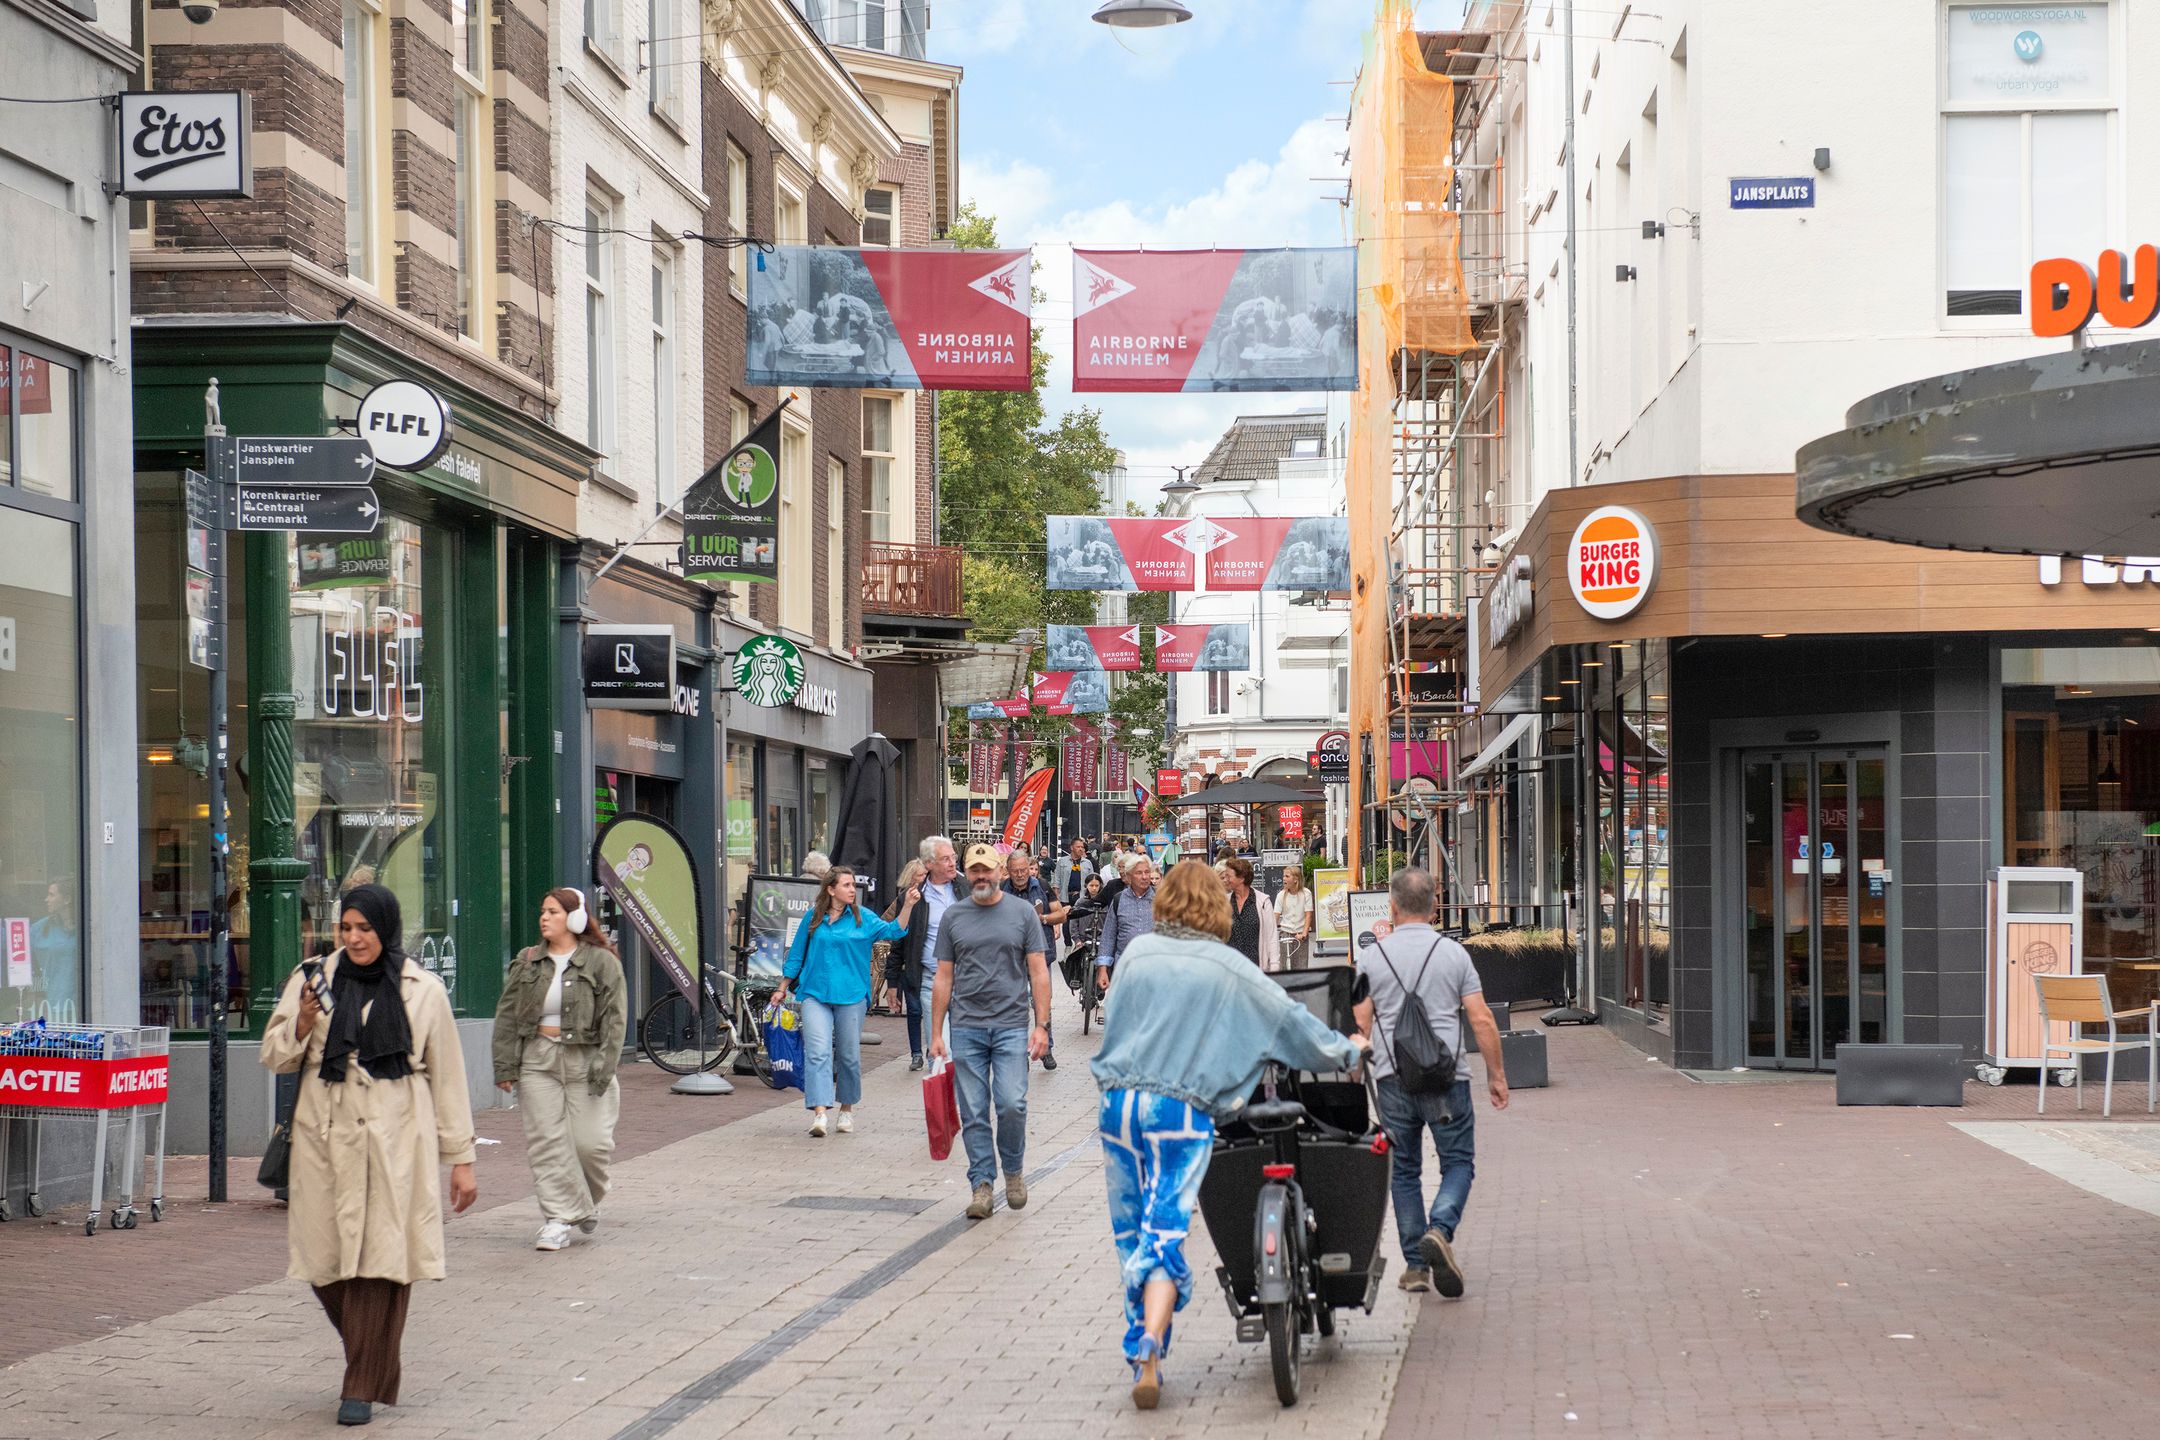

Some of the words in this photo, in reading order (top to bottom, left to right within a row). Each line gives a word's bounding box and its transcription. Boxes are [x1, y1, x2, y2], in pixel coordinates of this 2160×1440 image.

[1969, 10, 2087, 21] WOODWORKSYOGA.NL
[1996, 78, 2029, 90] urban
[2032, 79, 2060, 92] yoga
[133, 105, 226, 158] Etos
[1734, 186, 1809, 201] JANSPLAATS
[1090, 335, 1188, 349] AIRBORNE
[1090, 352, 1170, 366] ARNHEM
[370, 411, 430, 437] FLFL
[241, 444, 314, 453] Janskwartier
[241, 456, 295, 466] Jansplein
[456, 453, 481, 485] falafel
[242, 490, 322, 501] Korenkwartier
[256, 502, 304, 512] Centraal
[242, 514, 309, 524] Korenmarkt
[685, 514, 775, 523] DIRECTFIXPHONE.NL
[687, 534, 696, 554] 1
[702, 535, 738, 554] UUR
[1580, 541, 1640, 562] BURGER
[688, 555, 738, 567] SERVICE
[1213, 561, 1265, 569] AIRBORNE
[1581, 560, 1641, 588] KING
[1280, 808, 1301, 819] alles
[765, 896, 775, 912] 1
[787, 899, 810, 912] UUR
[0, 1068, 81, 1094] ACTIE
[108, 1070, 139, 1095] ACTIE
[138, 1067, 168, 1091] ACTIE
